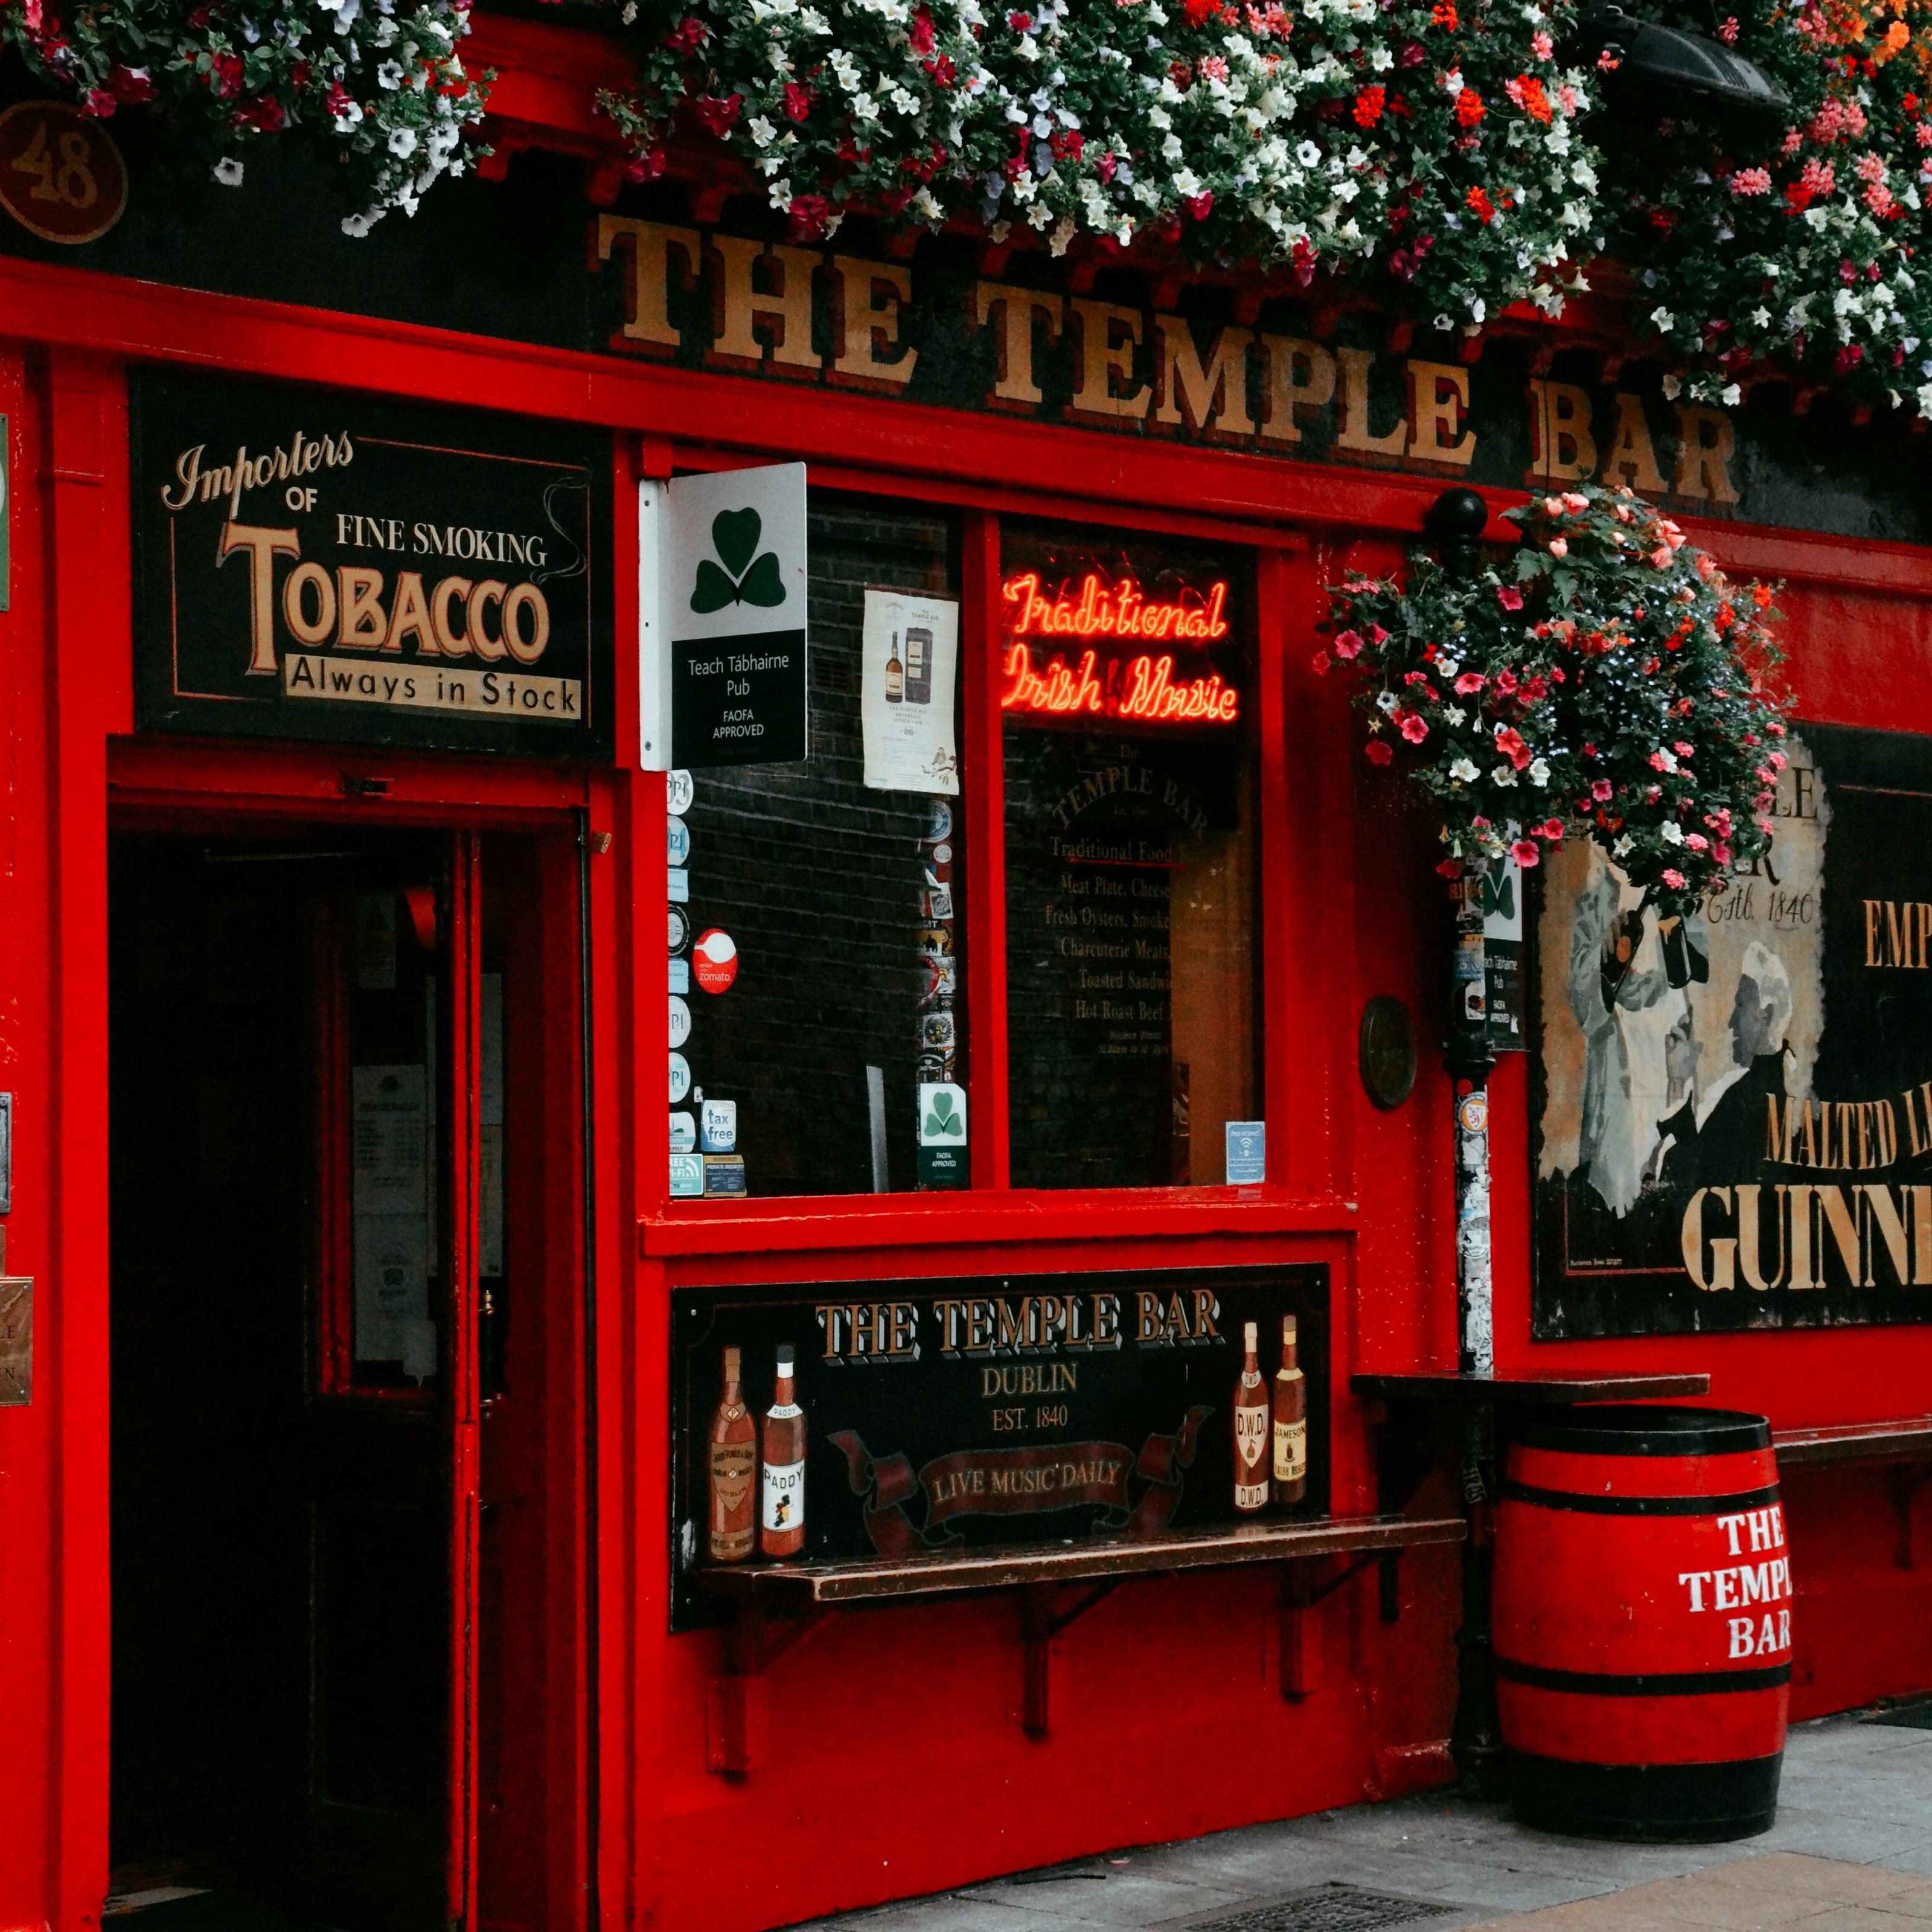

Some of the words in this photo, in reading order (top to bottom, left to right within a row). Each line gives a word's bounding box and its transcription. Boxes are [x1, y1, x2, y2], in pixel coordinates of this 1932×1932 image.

[11, 121, 98, 208] 48
[597, 213, 918, 385] THE
[976, 280, 1477, 465] TEMPLE
[1529, 377, 1740, 504] BAR
[161, 430, 354, 520] Importers
[286, 486, 318, 513] OF
[336, 513, 405, 551] FINE
[412, 528, 548, 567] SMOKING
[1002, 573, 1227, 638] Traditional
[688, 656, 724, 676] Teach
[728, 652, 790, 673] Tábhairne
[290, 656, 416, 706] Always
[437, 673, 465, 703] in
[482, 672, 575, 713] Stock
[726, 677, 750, 697] Pub
[1001, 644, 1101, 711] Irish
[1120, 656, 1236, 720] Music
[723, 708, 754, 723] FAOFA
[712, 724, 765, 740] APPROVED
[1052, 765, 1153, 829] TEMPLE
[1161, 777, 1208, 840] BAR
[1051, 836, 1132, 862] Traditional
[1138, 842, 1172, 862] Food
[1061, 874, 1090, 895] Meat
[1044, 904, 1078, 926] Fresh
[1131, 908, 1170, 929] Smoke
[1060, 936, 1130, 958] Charcuterie
[699, 972, 731, 982] zomato
[1078, 967, 1124, 989] Toasted
[1127, 970, 1170, 990] Sandwi
[1075, 999, 1097, 1020] Hot
[1102, 1000, 1136, 1020] Roast
[708, 1109, 729, 1125] tax
[708, 1126, 733, 1141] free
[1763, 1092, 1898, 1170] MALTED
[670, 1157, 684, 1166] REE
[815, 1302, 921, 1367] THE
[933, 1293, 1123, 1360] TEMPLE
[1135, 1288, 1227, 1349] BAR
[981, 1363, 1078, 1398] DUBLIN
[773, 1407, 796, 1416] PADDY
[993, 1407, 1029, 1431] EST.
[1036, 1404, 1068, 1428] 1840
[1238, 1413, 1265, 1437] D.W.D.
[1275, 1425, 1306, 1439] JAMESON
[764, 1465, 804, 1489] PADDY
[934, 1470, 985, 1505] LIVE
[991, 1467, 1057, 1495] MUSIC
[1061, 1459, 1121, 1488] DAILY
[720, 1486, 747, 1497] DUBLIN
[1241, 1486, 1263, 1506] D.W.D.
[1716, 1506, 1784, 1556] THE
[1678, 1556, 1793, 1613] TEMPL
[1726, 1609, 1791, 1659] BAR
